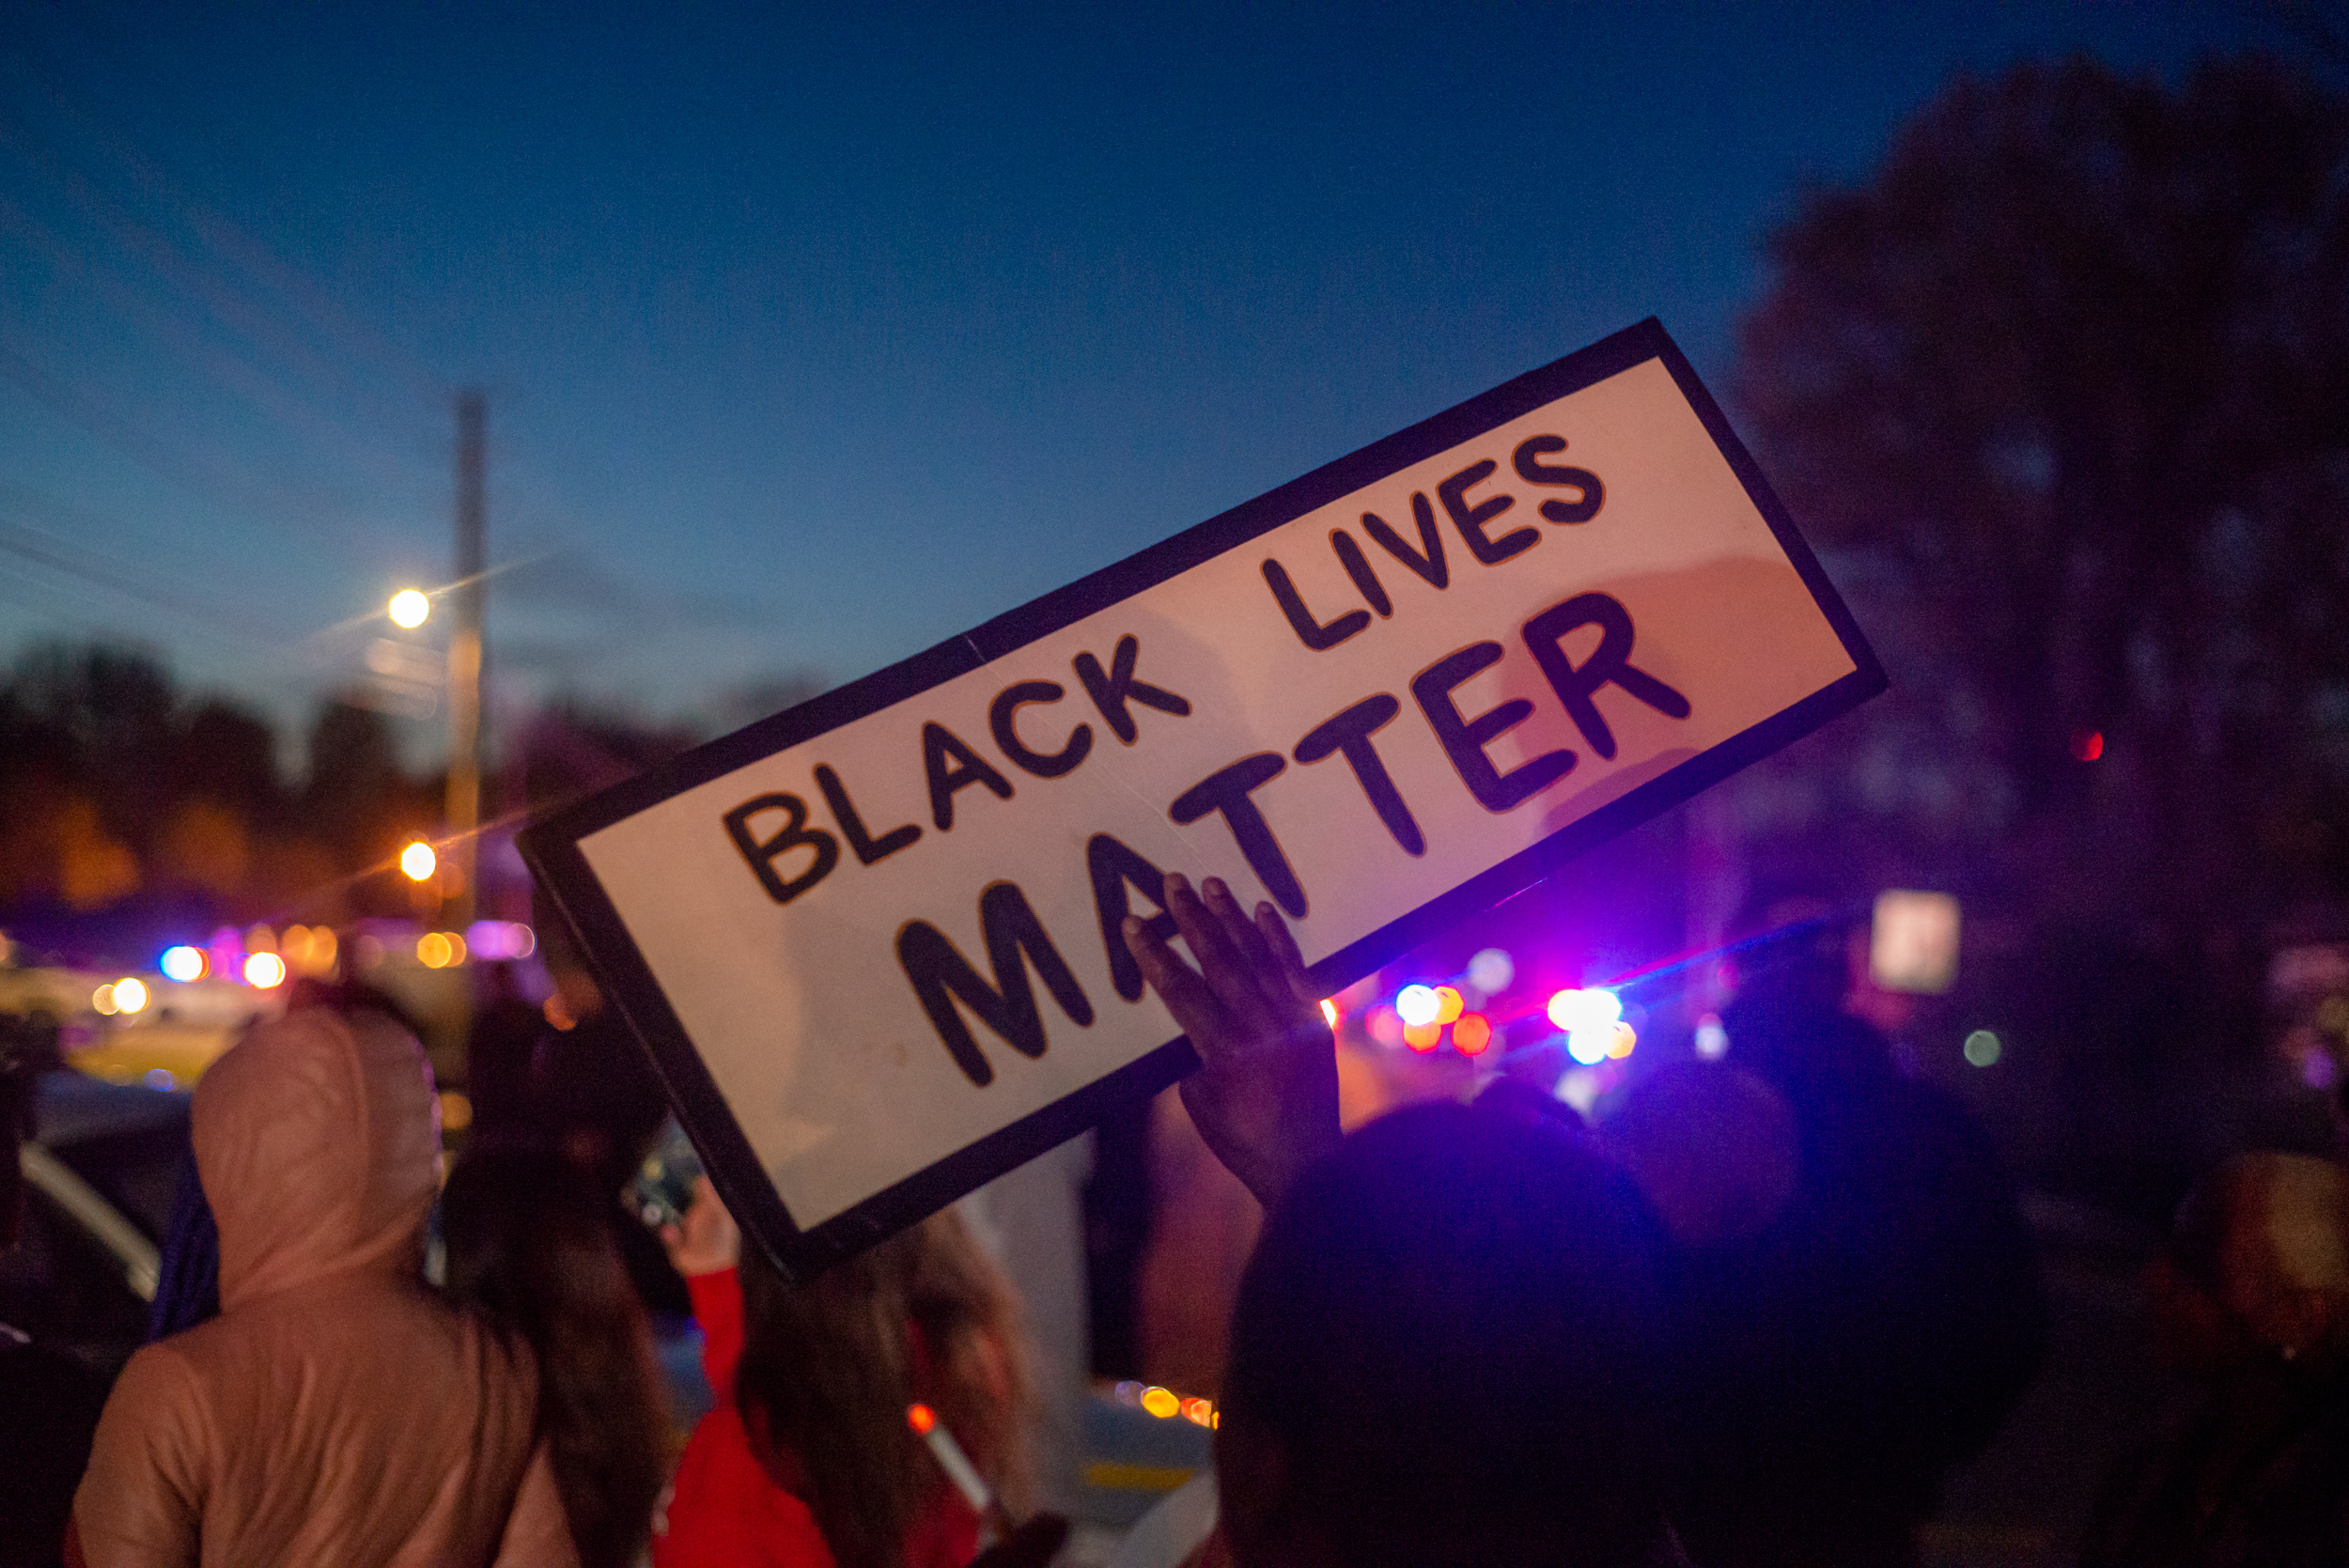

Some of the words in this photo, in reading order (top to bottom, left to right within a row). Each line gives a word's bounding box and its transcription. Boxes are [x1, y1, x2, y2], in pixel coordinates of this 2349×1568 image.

[723, 634, 1191, 905] BLACK
[1261, 435, 1605, 650] LIVES
[895, 593, 1690, 1087] MATTER
